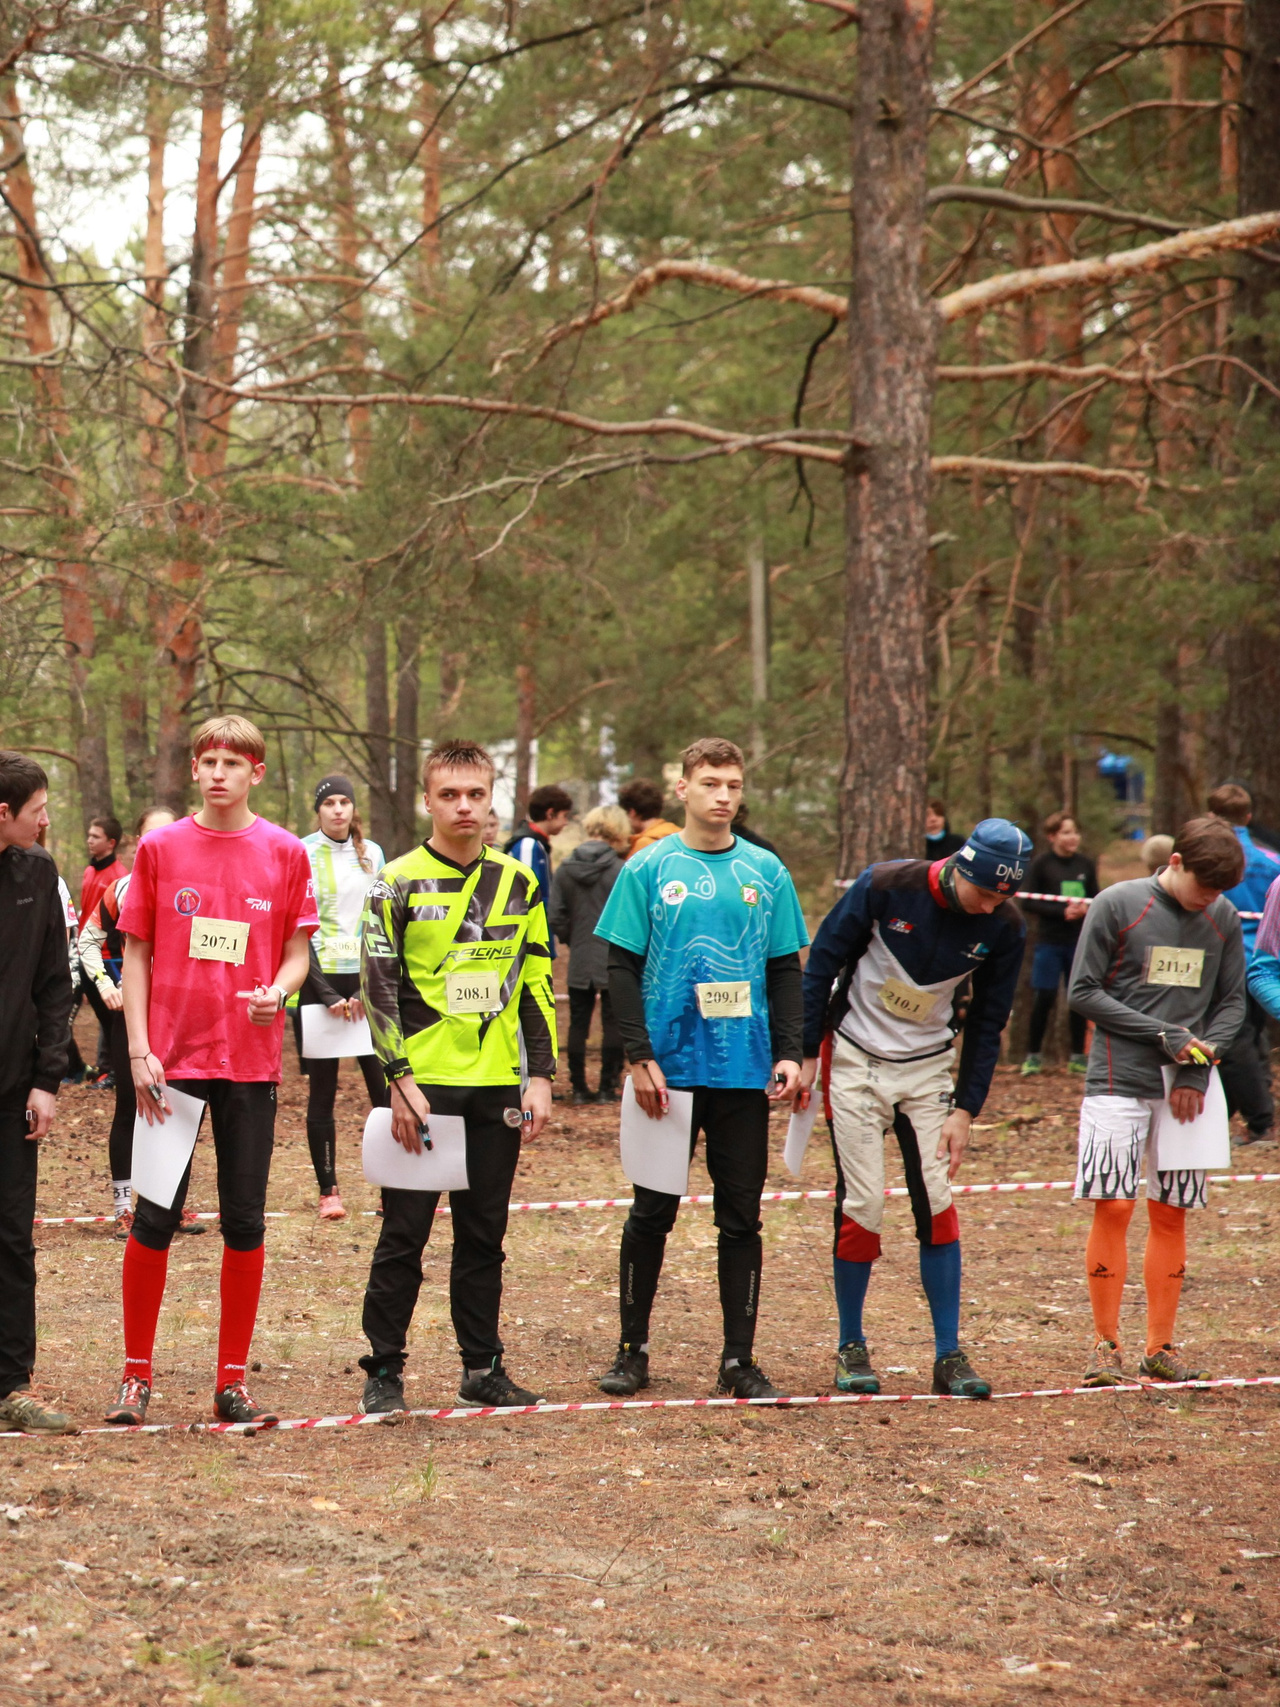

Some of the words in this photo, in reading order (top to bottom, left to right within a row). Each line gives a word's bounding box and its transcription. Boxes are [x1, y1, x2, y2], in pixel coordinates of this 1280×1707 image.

[995, 860, 1024, 882] DNB
[200, 934, 238, 951] 207.1
[1157, 959, 1190, 974] 211.1
[455, 987, 490, 1001] 208.1
[704, 991, 739, 1004] 209.1
[886, 992, 921, 1013] 210.1
